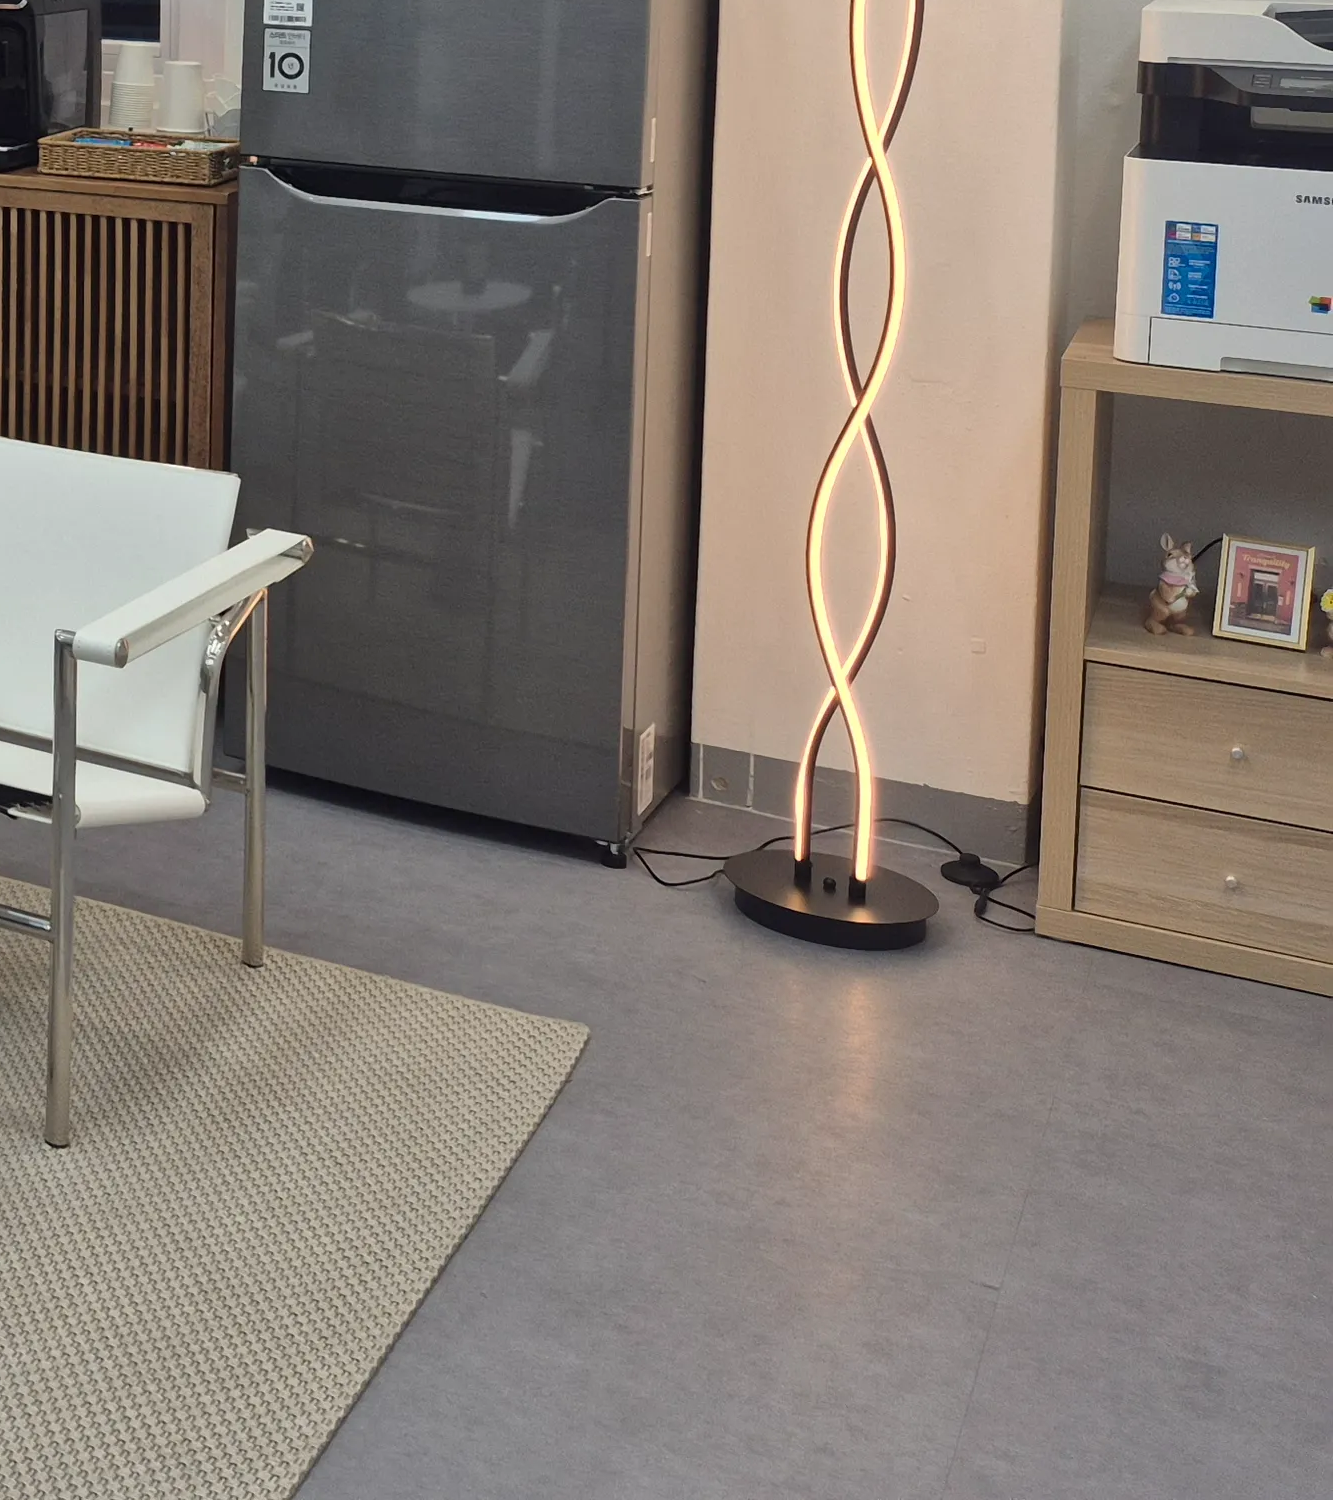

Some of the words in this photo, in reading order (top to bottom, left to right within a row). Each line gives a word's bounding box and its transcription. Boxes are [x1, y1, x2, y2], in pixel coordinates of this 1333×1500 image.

[269, 51, 305, 80] 10
[1295, 194, 1333, 206] SAMS
[1242, 554, 1291, 570] Tranquility
